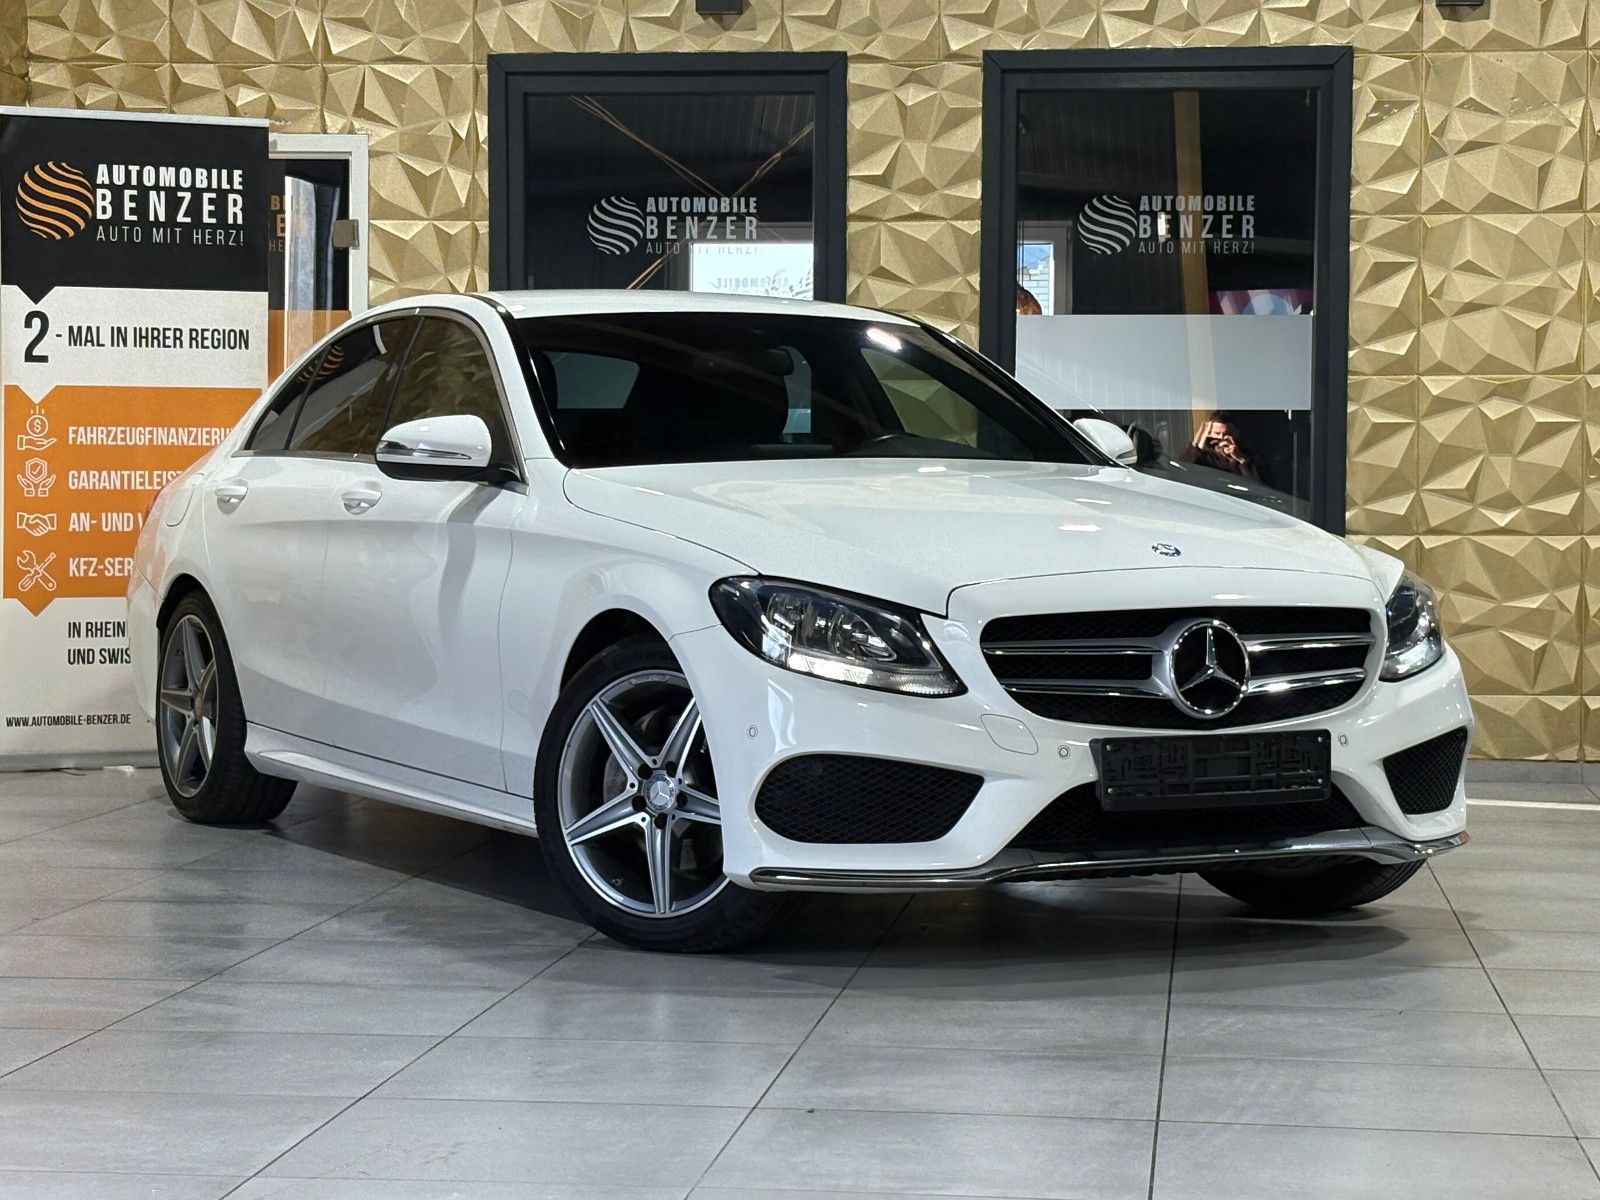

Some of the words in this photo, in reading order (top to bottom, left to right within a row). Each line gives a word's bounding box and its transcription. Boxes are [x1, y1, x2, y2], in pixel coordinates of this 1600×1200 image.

[96, 163, 243, 190] AUTOMOBILE
[96, 188, 243, 225] BENZER
[646, 196, 757, 213] AUTOMOBILE
[1139, 194, 1255, 212] AUTOMOBILE
[96, 225, 142, 243] AUTO
[152, 228, 182, 244] MIT
[193, 229, 244, 246] HERZ!
[646, 215, 757, 240] BENZER
[1138, 214, 1255, 239] BENZER
[646, 241, 680, 255] AUTO
[1138, 239, 1173, 254] AUTO
[1181, 240, 1206, 254] MIT
[1213, 240, 1255, 254] HERZ!
[24, 310, 50, 363] 2
[68, 325, 106, 348] MAL
[110, 326, 128, 348] IN
[133, 326, 184, 349] IHRER
[188, 327, 250, 351] REGION
[68, 470, 183, 490] GARANTIELEIS
[68, 512, 97, 532] AN-
[101, 512, 134, 532] UND
[69, 557, 133, 577] KFZ-SER
[68, 621, 82, 638] IN
[85, 621, 126, 638] RHEIN
[67, 648, 95, 665] UND
[99, 647, 132, 665] SWIS
[5, 713, 132, 728] WWW.AUTOMOBILE-BENZER.DE
